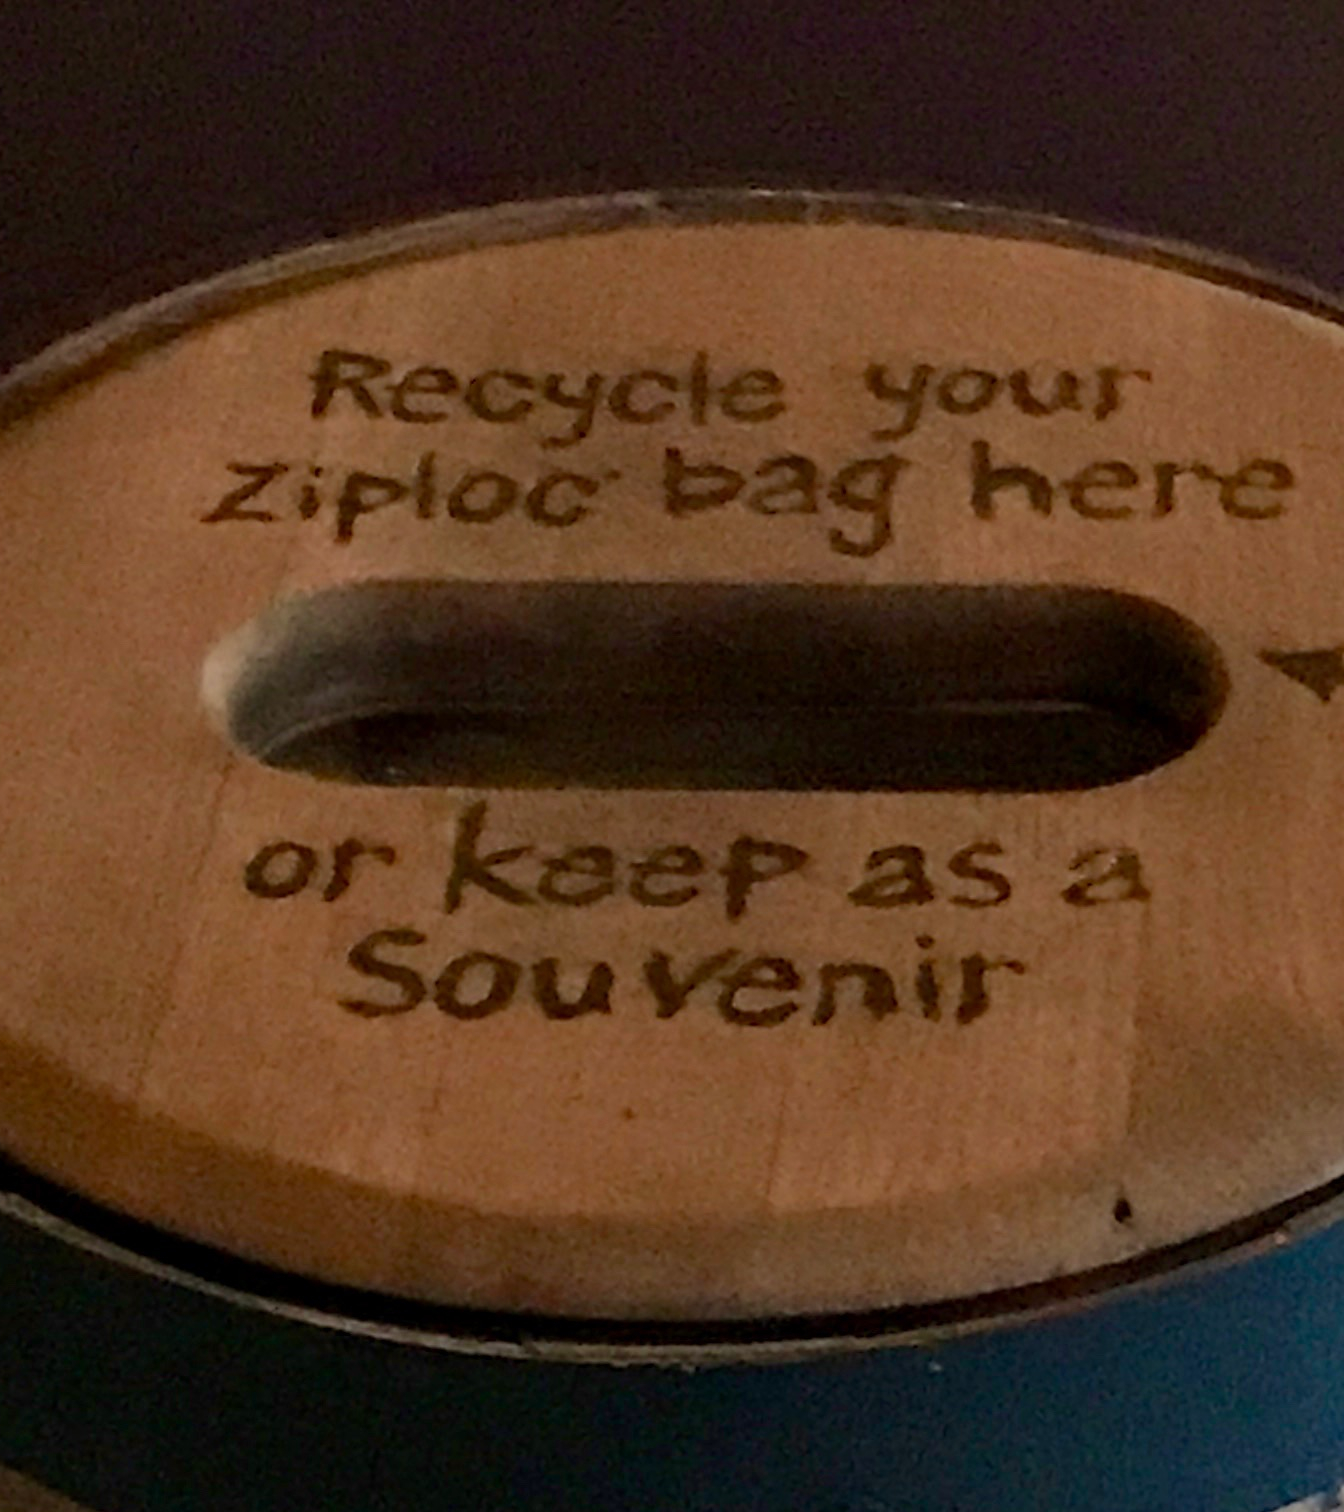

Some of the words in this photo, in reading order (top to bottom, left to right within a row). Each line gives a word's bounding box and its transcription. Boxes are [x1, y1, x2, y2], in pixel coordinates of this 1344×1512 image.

[308, 347, 787, 448] Recycle
[863, 352, 1152, 440] your
[199, 452, 622, 542] ziploc
[664, 446, 912, 556] bag
[969, 442, 1296, 522] here
[243, 835, 394, 902] or
[442, 804, 808, 918] keep
[849, 840, 1012, 908] as
[1062, 845, 1152, 906] a
